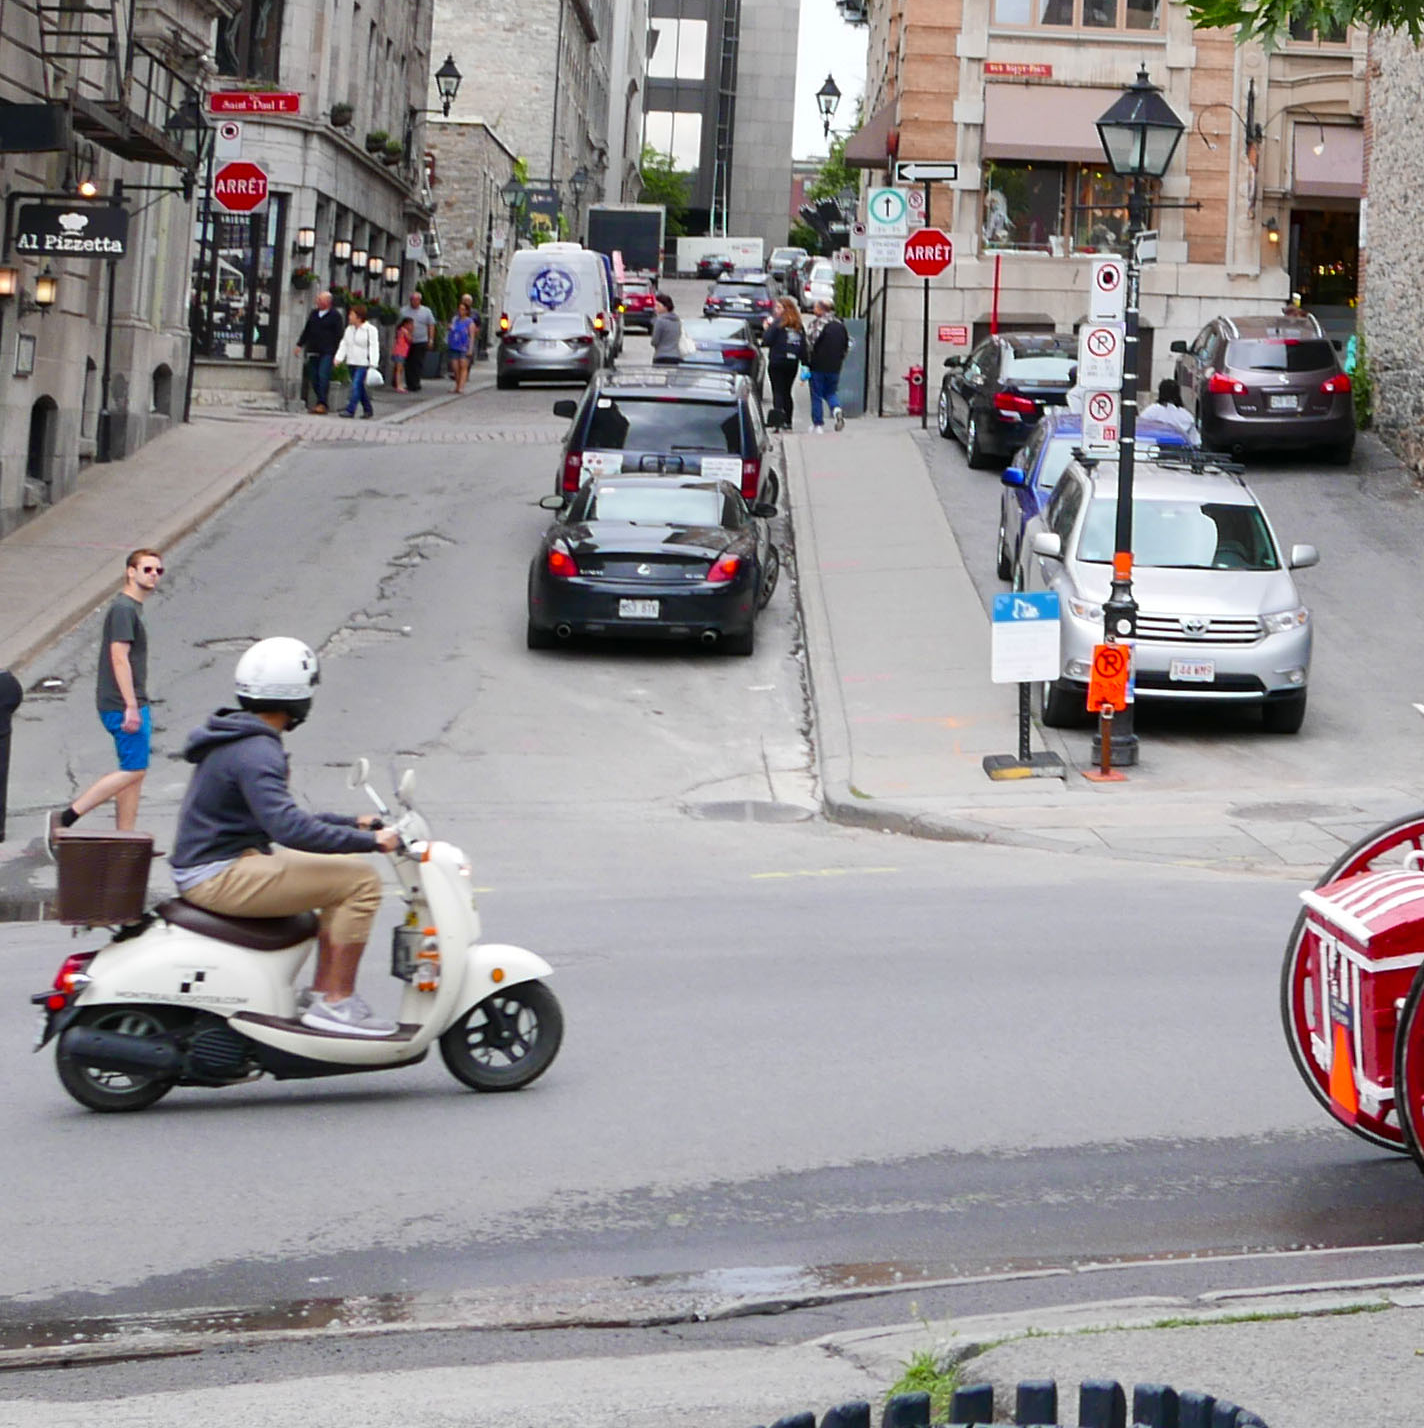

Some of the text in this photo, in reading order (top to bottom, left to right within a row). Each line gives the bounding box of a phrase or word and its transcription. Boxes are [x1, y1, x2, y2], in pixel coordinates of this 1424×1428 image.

[215, 177, 266, 195] ARRÊT
[18, 233, 124, 253] Al Pizzetta
[905, 243, 952, 261] ARRÊT
